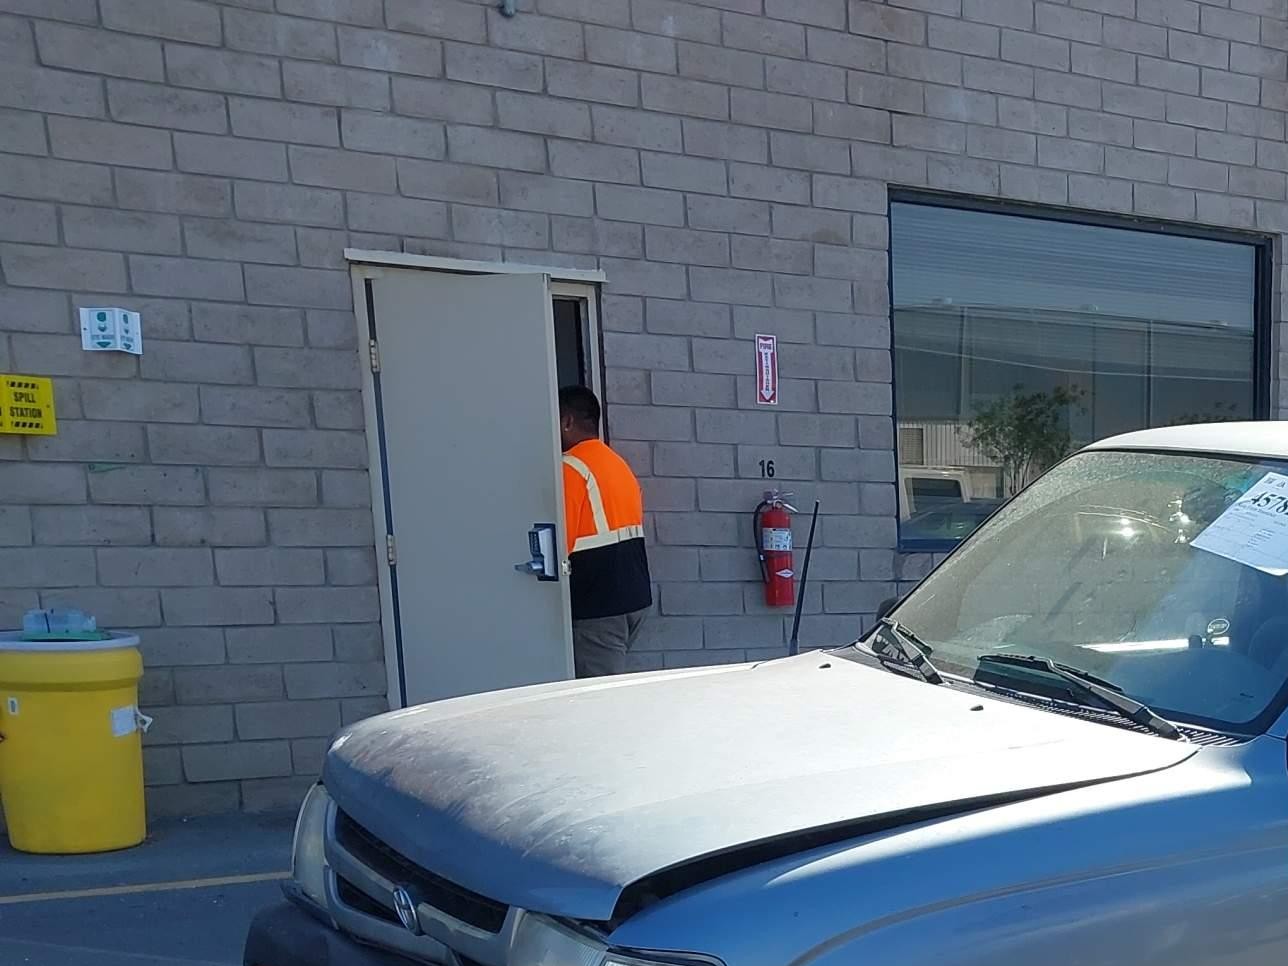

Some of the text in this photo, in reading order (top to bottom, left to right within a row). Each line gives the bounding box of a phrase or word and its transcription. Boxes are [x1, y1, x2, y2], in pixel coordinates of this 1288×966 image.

[14, 391, 36, 403] SPILL
[9, 406, 42, 418] STATION
[759, 460, 775, 478] 16
